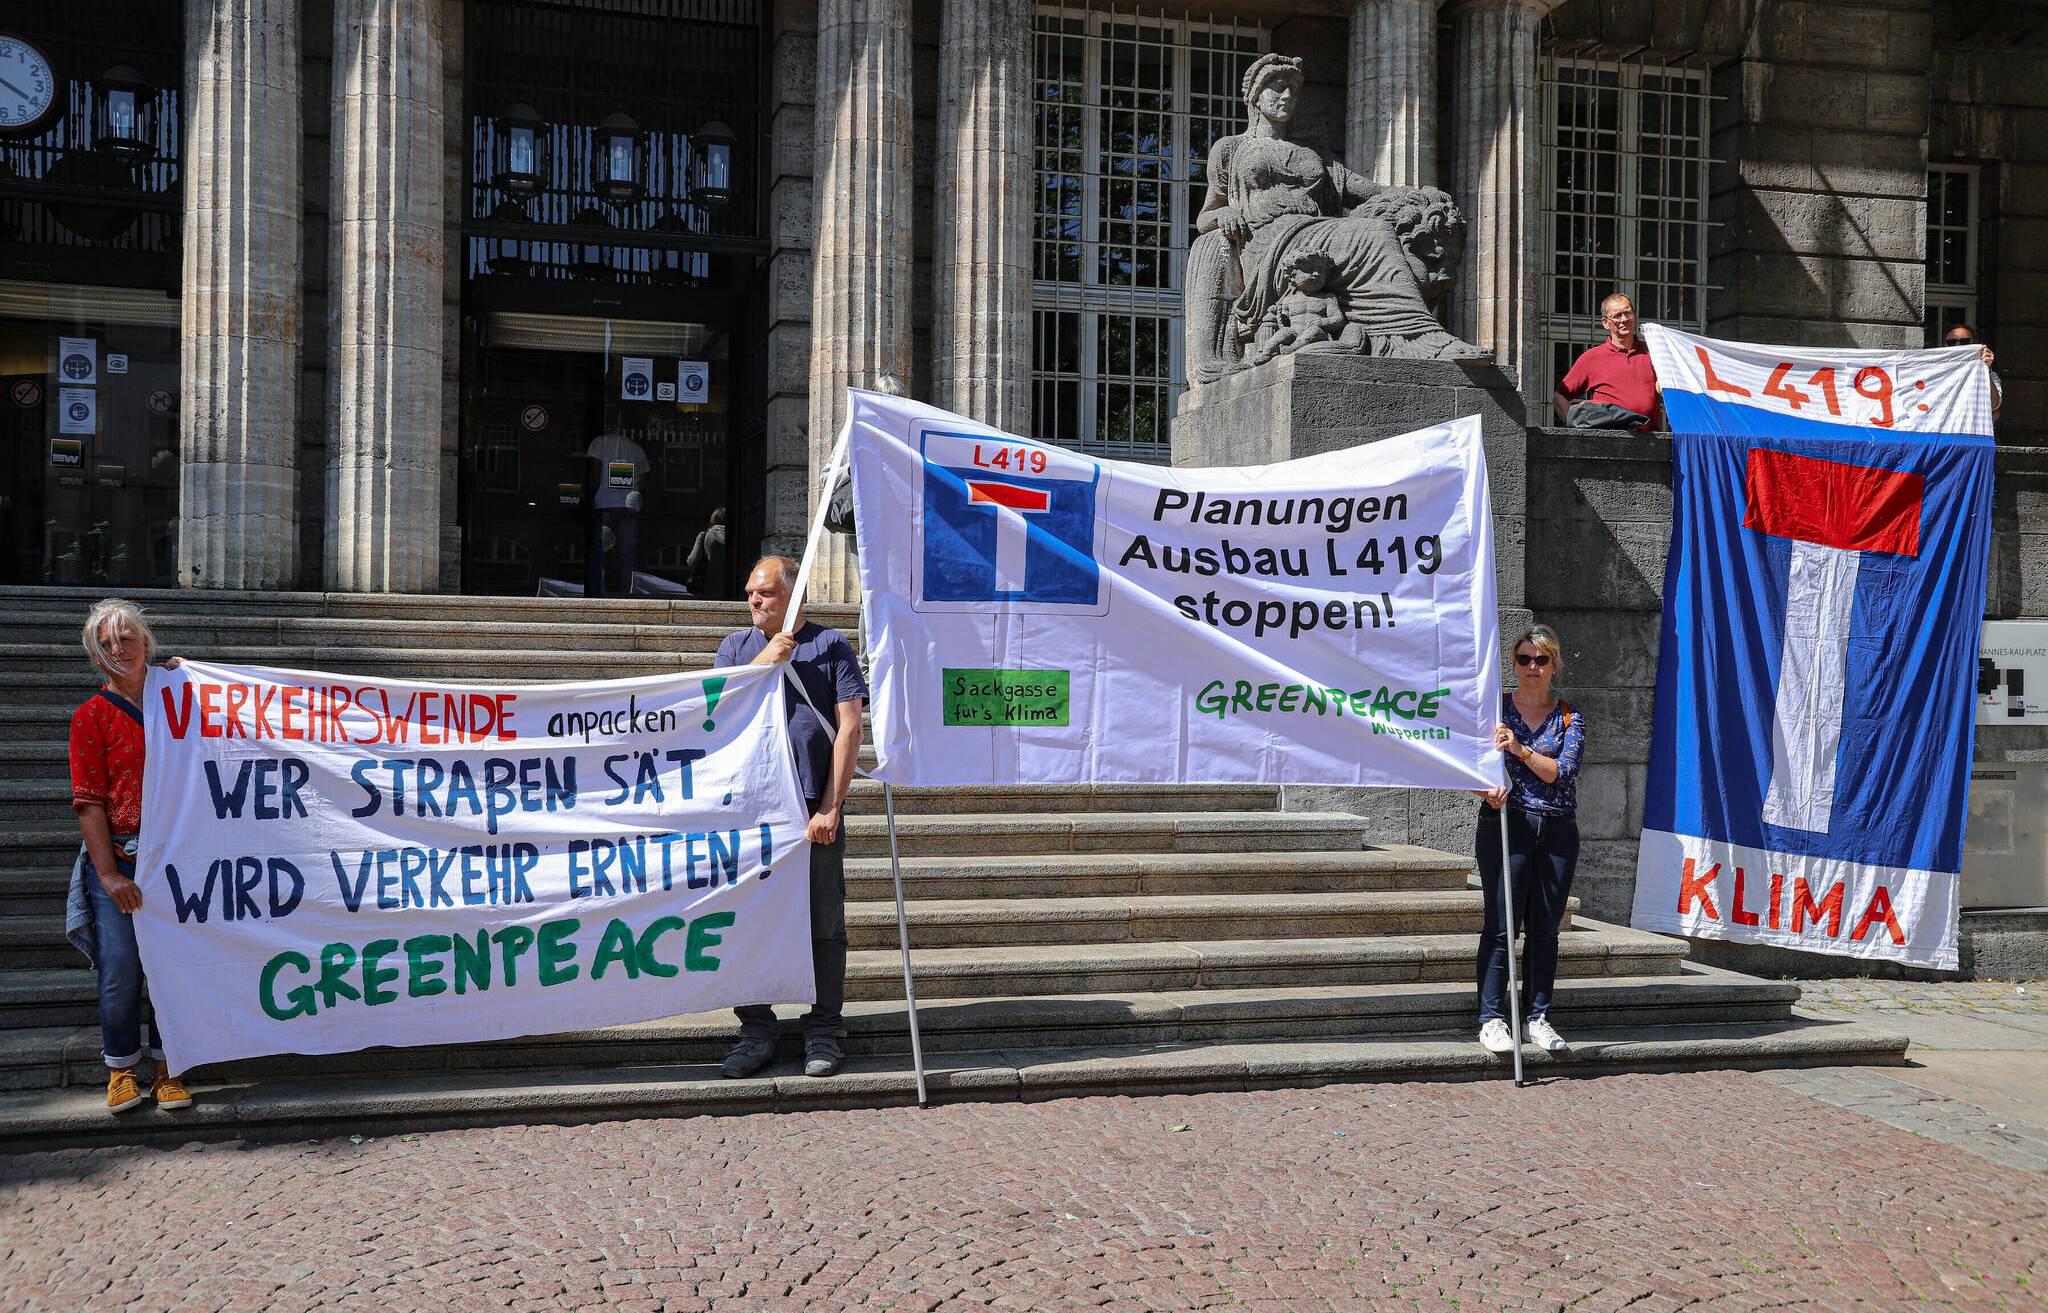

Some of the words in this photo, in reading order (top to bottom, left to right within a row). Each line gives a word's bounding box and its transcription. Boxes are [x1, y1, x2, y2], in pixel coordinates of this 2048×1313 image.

[973, 444, 1047, 473] L419
[1153, 488, 1408, 533] Planungen
[1119, 534, 1311, 577] Ausbau
[1173, 592, 1396, 639] stoppen!
[161, 681, 518, 744] VERKEHRSWENDE
[547, 694, 676, 744] anpacken
[953, 676, 1057, 703] Sackgasse
[1195, 679, 1451, 723] GREENPEACE
[1370, 721, 1451, 740] Wuppertal
[204, 758, 310, 820] WER
[165, 856, 305, 924] WIRD
[330, 840, 539, 913] VERKEHR
[1677, 857, 1905, 946] KLIMA
[258, 910, 736, 1021] GREENPEACE
